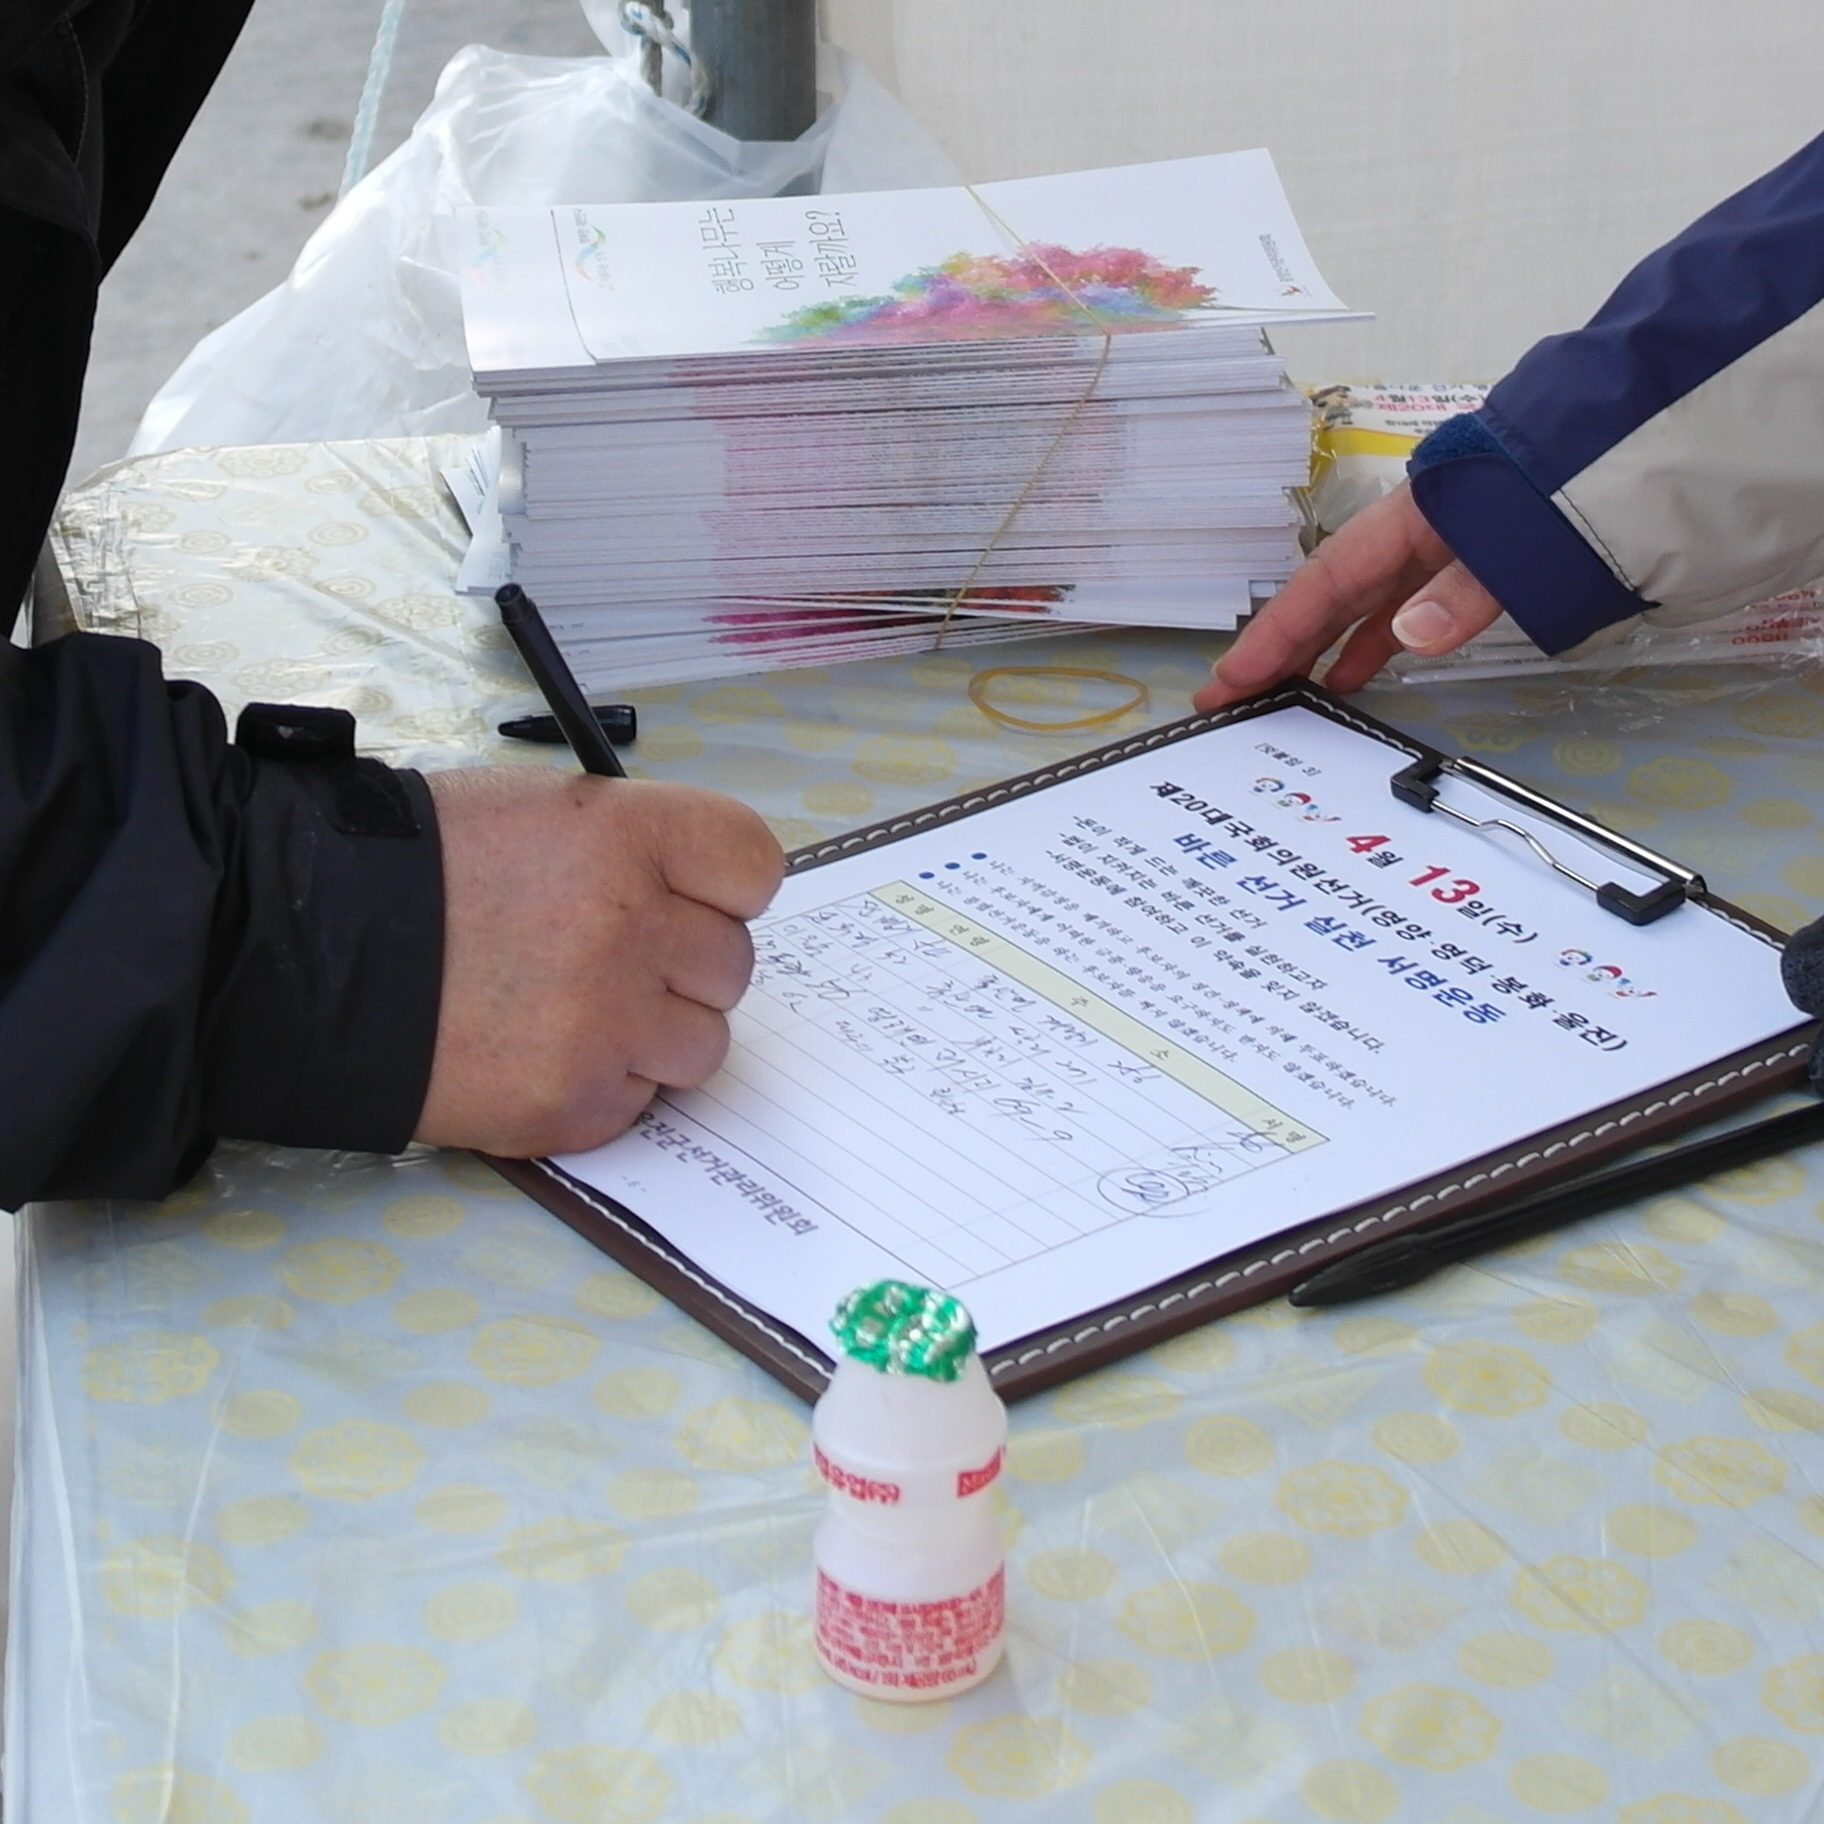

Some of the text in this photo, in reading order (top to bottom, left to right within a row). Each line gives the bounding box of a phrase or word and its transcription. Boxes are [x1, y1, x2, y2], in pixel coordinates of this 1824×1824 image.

[698, 207, 754, 294] 행복나무는
[756, 240, 805, 291] 어떻게
[805, 210, 858, 288] 자랄까요?
[1095, 853, 1158, 890] 지켜지는
[1160, 890, 1195, 912] 바른
[1193, 913, 1246, 943] 선거를
[1244, 944, 1328, 990] 실현하고자
[1172, 832, 1507, 1024] 바른 선거 실천 서명운동
[1181, 876, 1231, 907] 깨끗한
[1228, 908, 1268, 929] 선거
[1345, 834, 1538, 943] 4월 13일(수)
[1123, 895, 1189, 935] 참여하고
[1190, 935, 1212, 948] 이
[1212, 949, 1261, 980] 약속을
[1259, 979, 1300, 1001] 잊지
[1298, 1001, 1385, 1054] 않겠습니다.
